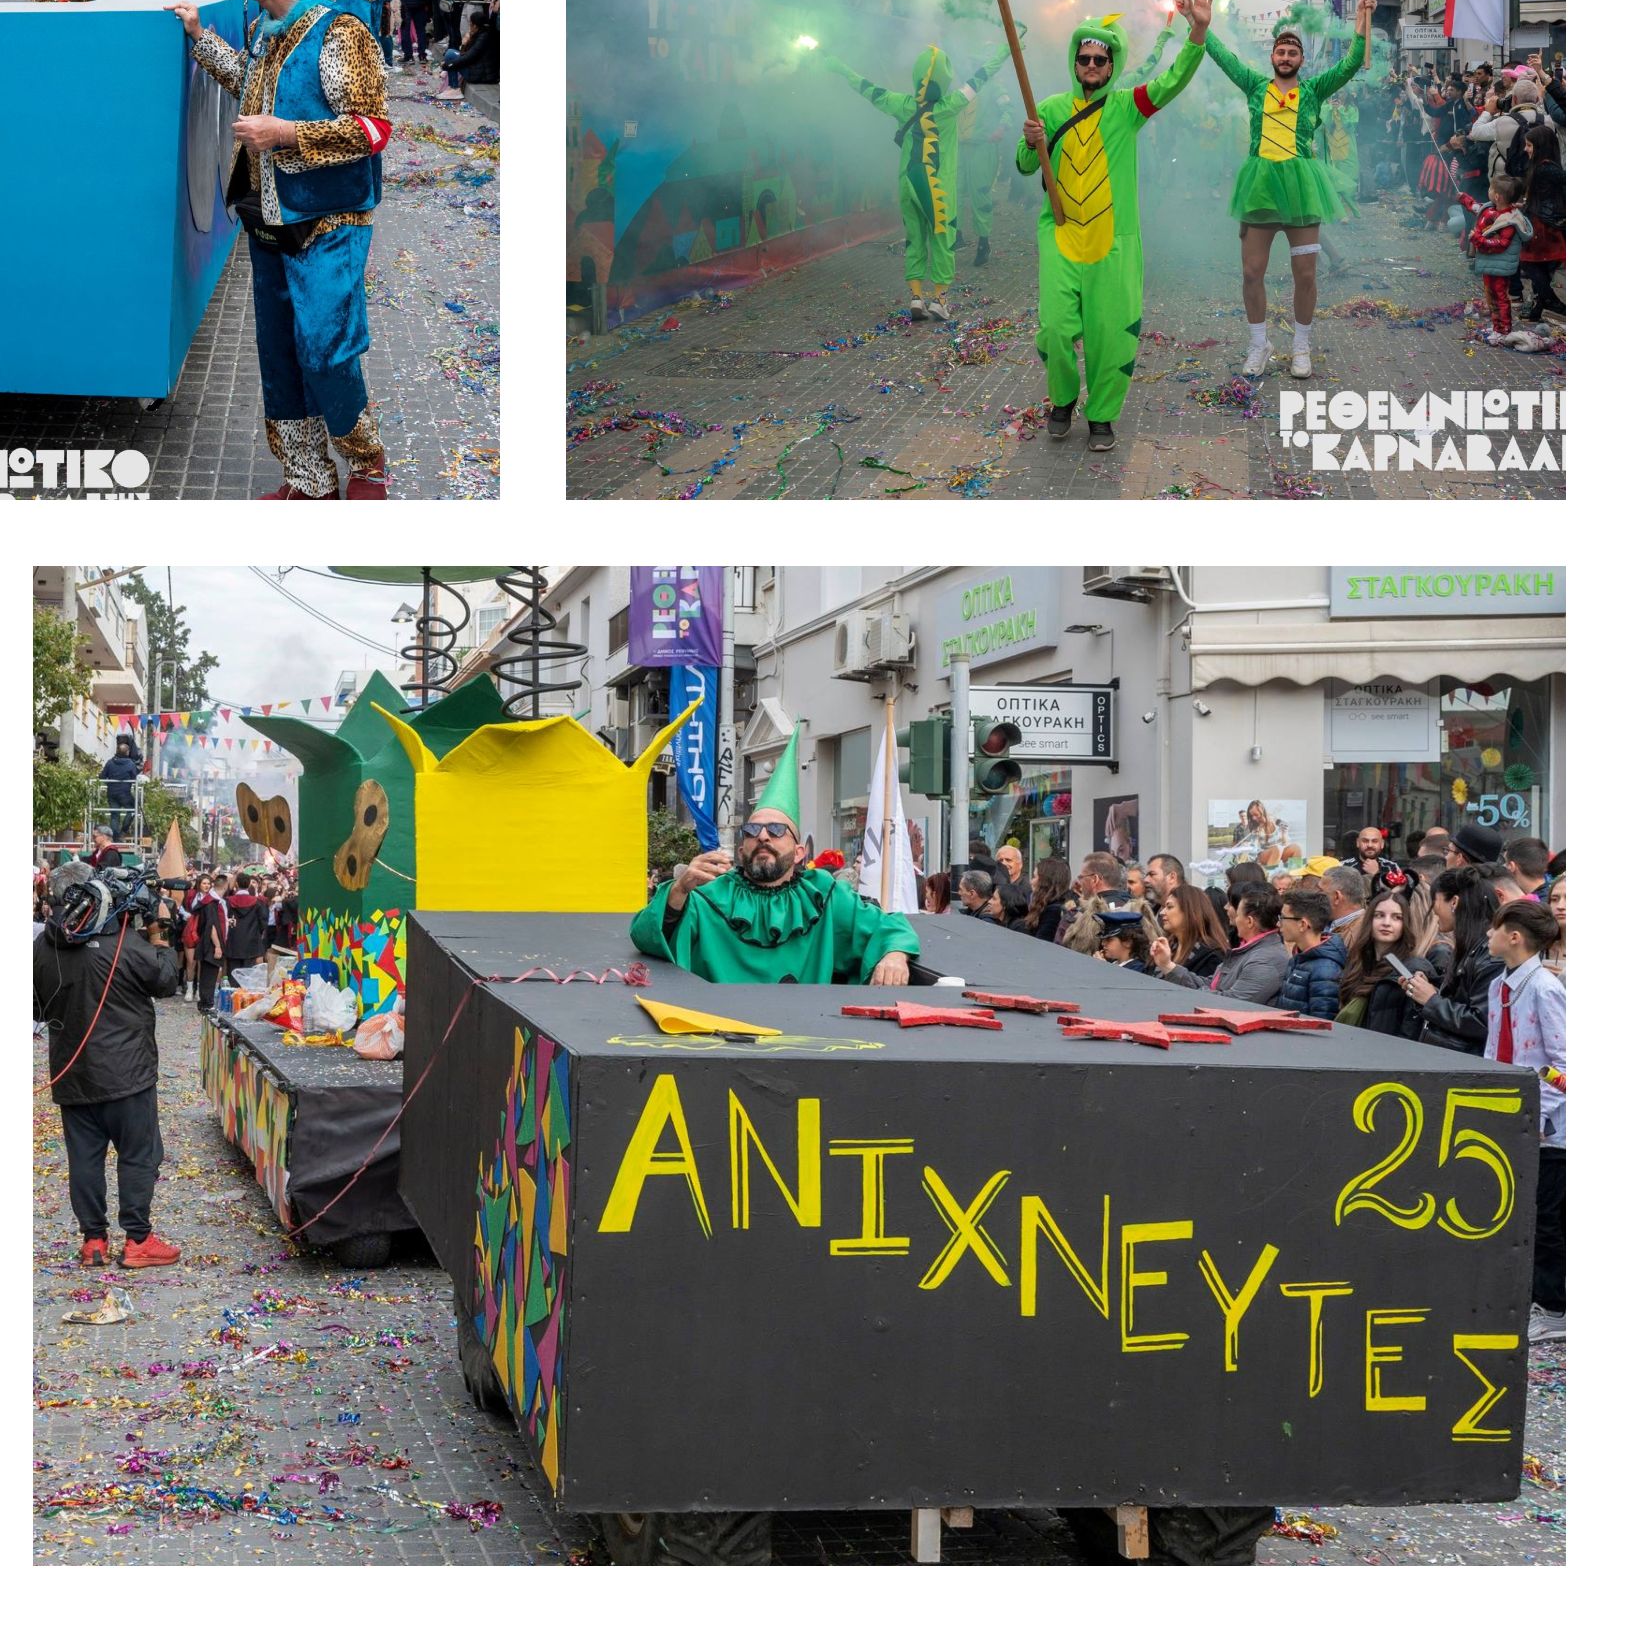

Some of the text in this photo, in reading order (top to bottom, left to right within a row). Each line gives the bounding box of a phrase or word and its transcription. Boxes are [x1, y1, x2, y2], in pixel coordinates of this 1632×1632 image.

[1347, 572, 1556, 601] ΣΤΑΓΚΟΥΡΑΚΗ
[960, 575, 1015, 621] ΟΠΤΙΚΑ
[1354, 684, 1403, 695] ΟΠΤΙΚΑ
[997, 697, 1061, 712] ΟΠΤΙΚΑ
[1335, 697, 1422, 707] ΣΤΑΓΚΟΥΡΑΚΗ
[1097, 696, 1106, 752] OPTICS
[1370, 711, 1410, 721] see smart
[1018, 739, 1069, 750] see smart
[1334, 1081, 1522, 1240] 25
[598, 1073, 1520, 1445] ΑΝΙΧΝΕΥΤΕΣ
